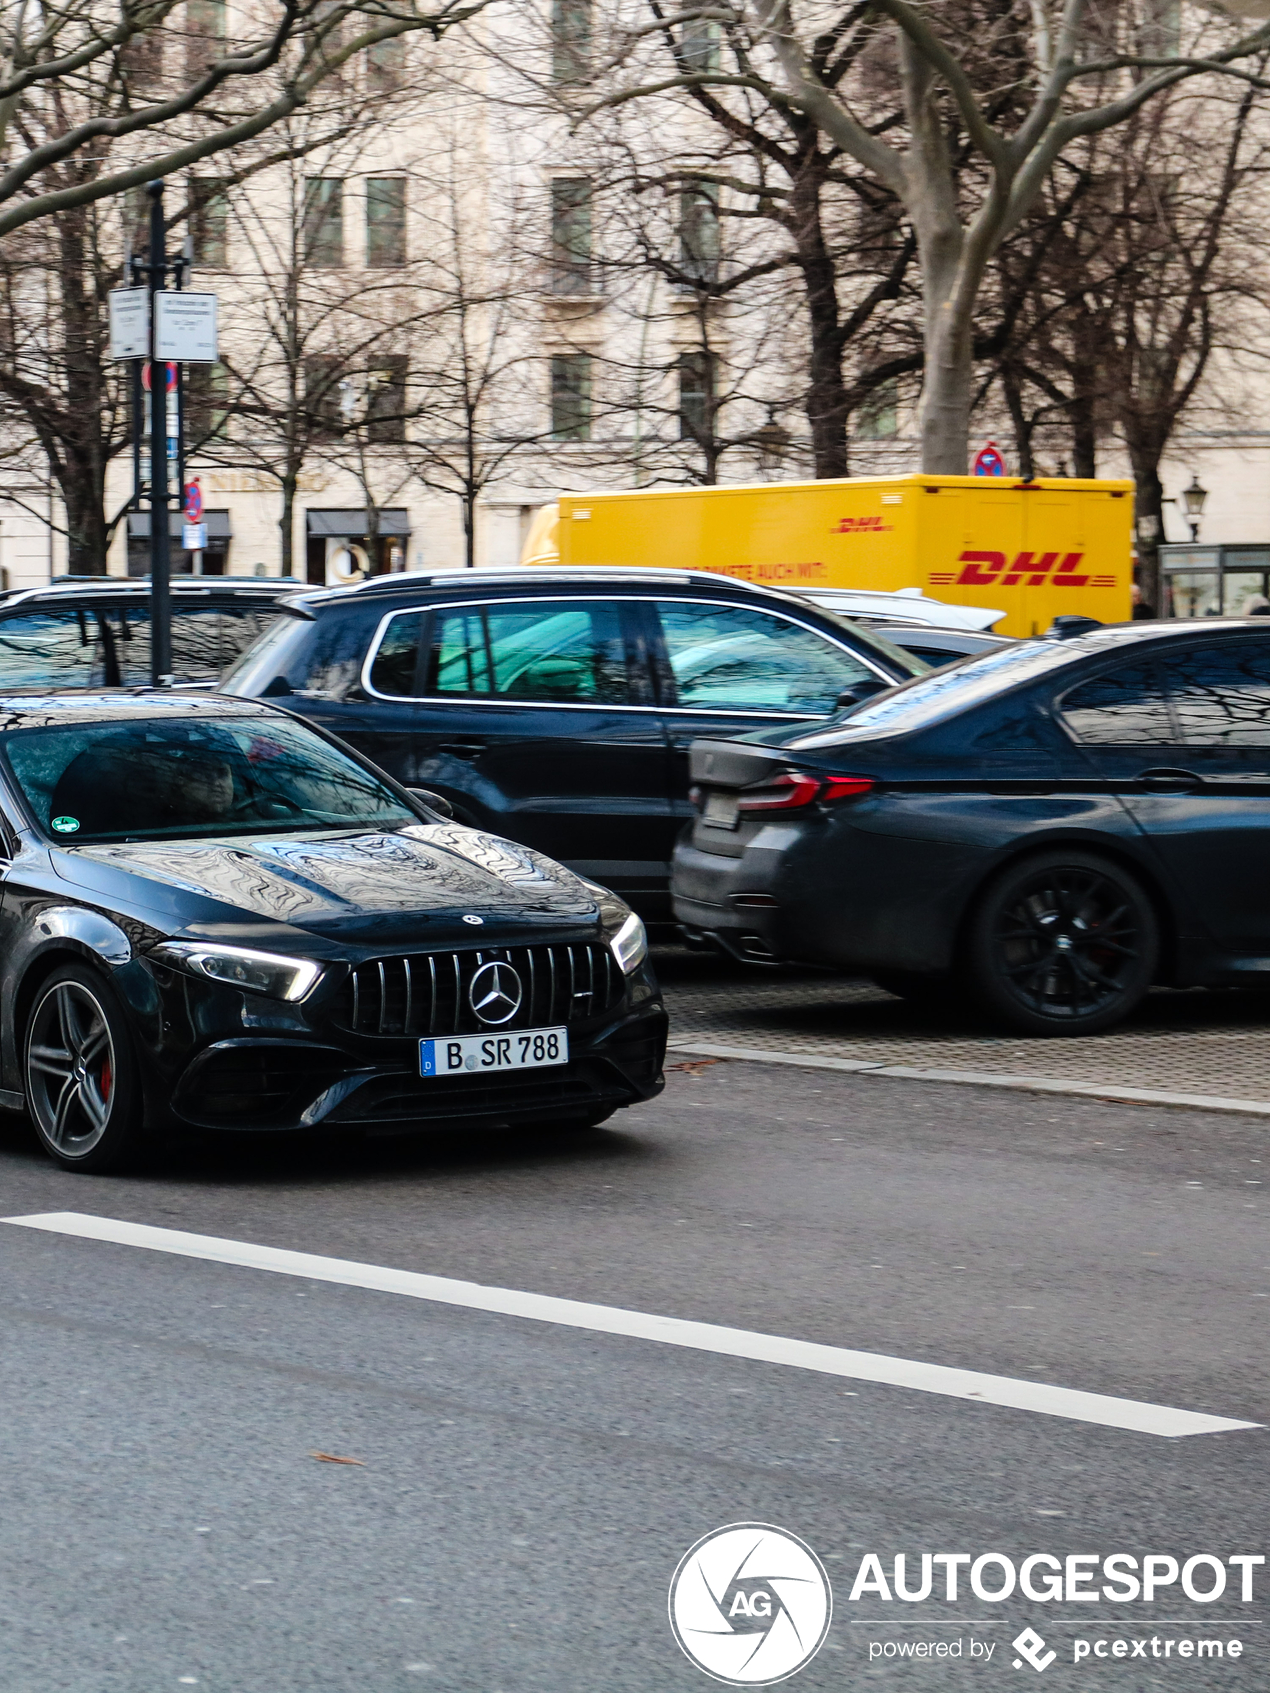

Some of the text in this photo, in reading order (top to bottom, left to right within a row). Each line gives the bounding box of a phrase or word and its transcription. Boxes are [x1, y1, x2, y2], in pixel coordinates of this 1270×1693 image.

[838, 517, 883, 533] DHL
[956, 551, 1090, 586] DHL
[447, 1034, 559, 1069] B SR 788
